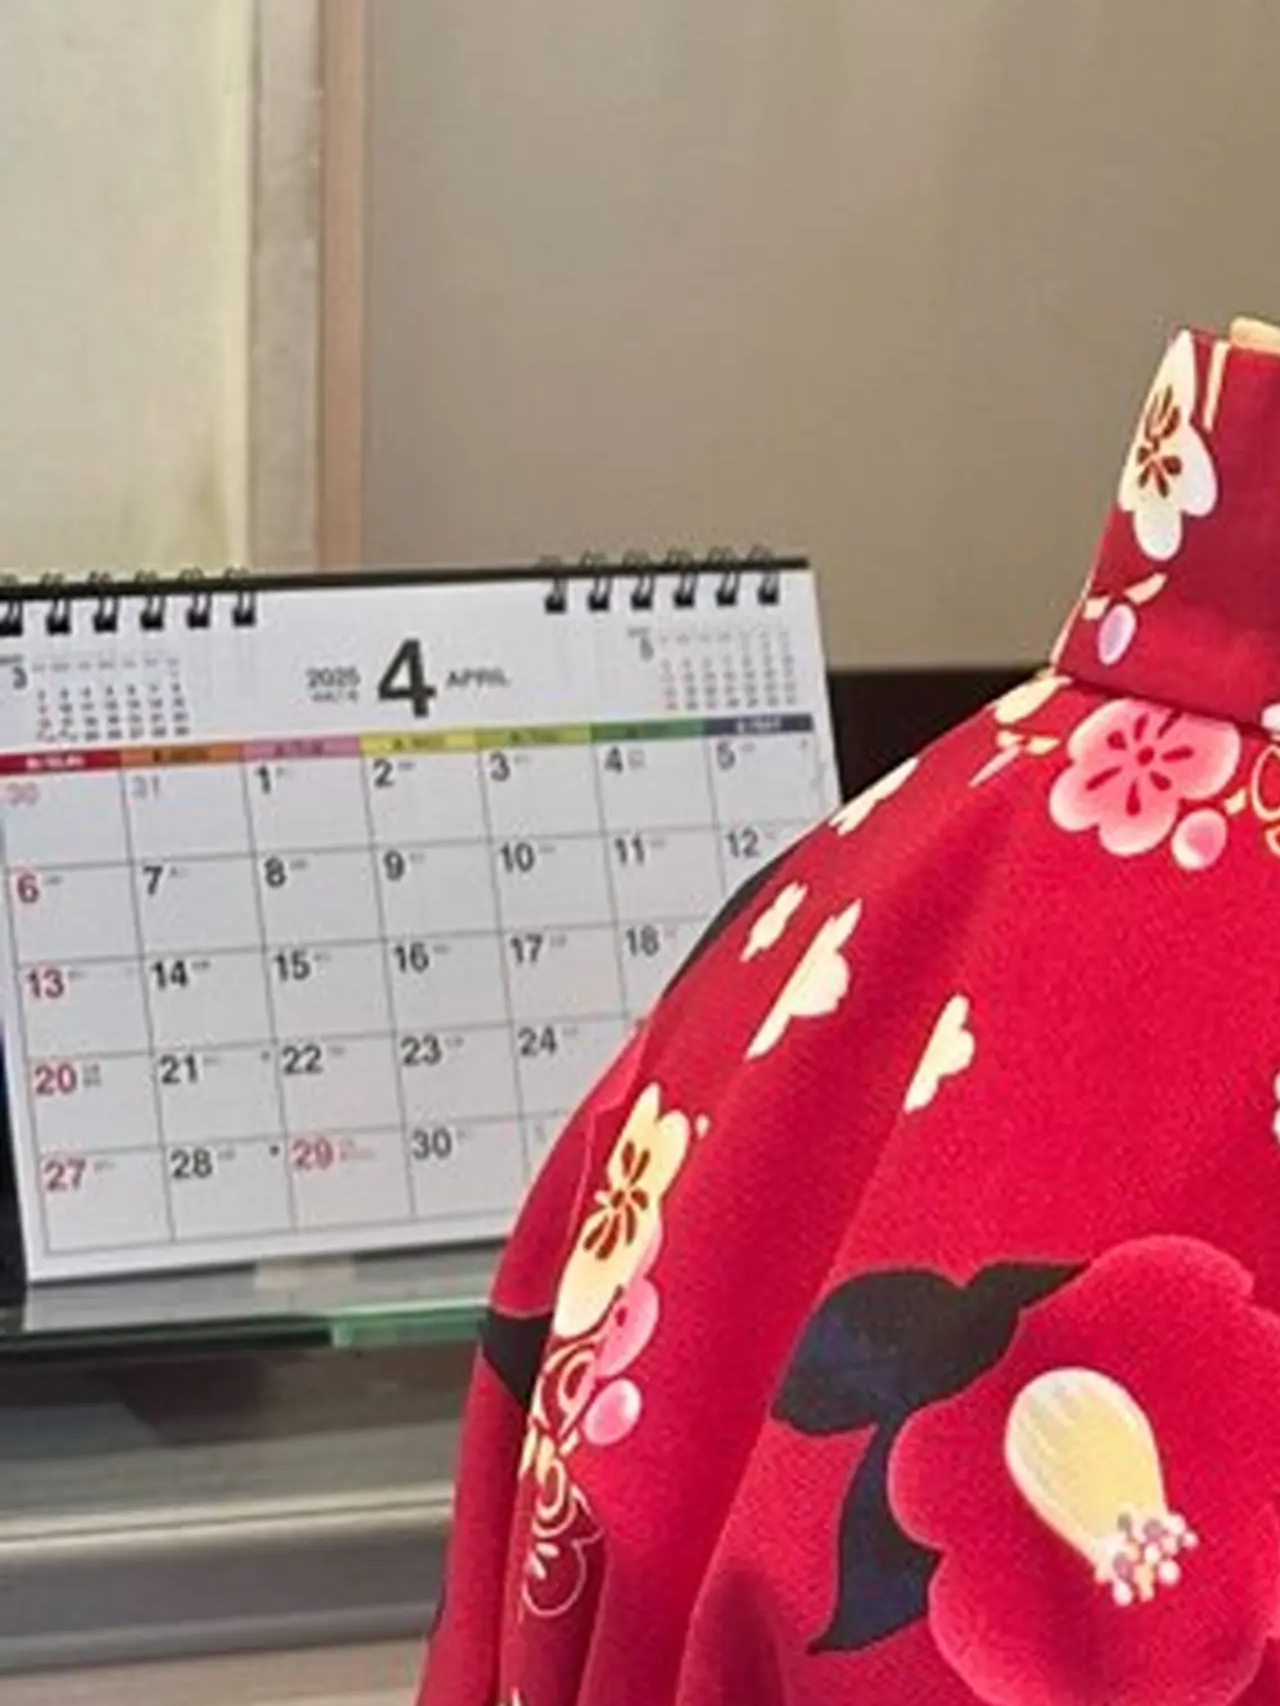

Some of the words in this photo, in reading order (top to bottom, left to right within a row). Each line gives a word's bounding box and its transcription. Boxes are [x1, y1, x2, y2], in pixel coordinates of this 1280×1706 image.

[304, 666, 361, 689] 2025
[377, 638, 437, 718] 4
[446, 668, 511, 689] APRIL
[256, 765, 271, 793] 1
[373, 758, 393, 787] 2
[490, 752, 510, 781] 3
[605, 746, 624, 773] 4
[716, 741, 736, 770] 5
[16, 872, 39, 904] 6
[143, 865, 163, 896] 7
[264, 857, 287, 888] 8
[384, 849, 405, 880] 9
[500, 842, 534, 872] 10
[614, 834, 645, 865] 11
[725, 826, 759, 858] 12
[28, 967, 64, 998] 13
[153, 959, 188, 989] 14
[274, 950, 311, 981] 15
[395, 942, 428, 973] 16
[510, 934, 543, 964] 17
[626, 925, 660, 956] 18
[34, 1062, 76, 1094] 20
[160, 1054, 198, 1084] 21
[281, 1044, 323, 1075] 22
[400, 1035, 443, 1066] 23
[517, 1026, 557, 1056] 24
[44, 1157, 86, 1192] 27
[170, 1149, 212, 1179] 28
[290, 1139, 333, 1170] 29
[410, 1127, 452, 1160] 30
